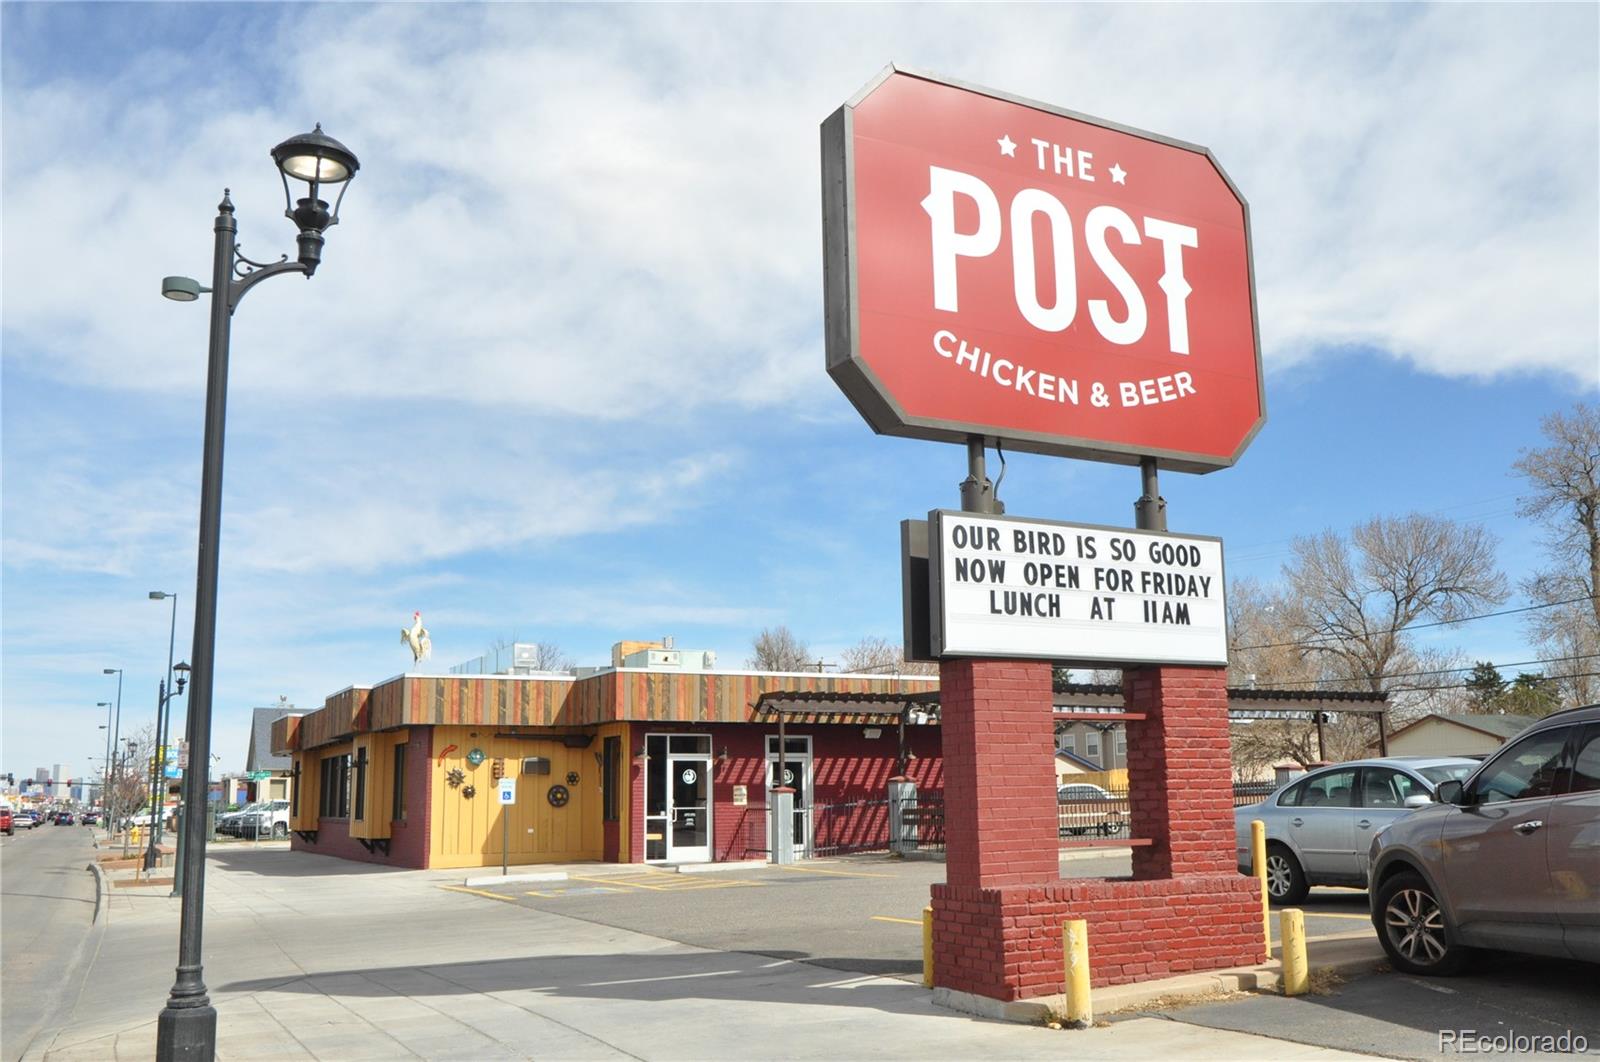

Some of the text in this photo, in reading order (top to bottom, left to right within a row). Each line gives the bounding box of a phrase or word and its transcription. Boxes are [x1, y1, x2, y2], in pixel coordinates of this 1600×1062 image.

[1031, 138, 1095, 182] THE
[920, 165, 1198, 355] POST
[933, 329, 1197, 408] CHICKEN & BEER
[952, 524, 1201, 568] OUR BIRD IS SO GOOD
[955, 557, 1211, 598] NOW OPEN FOR FRIDAY
[990, 590, 1061, 618] LUNCH
[1090, 597, 1115, 620] AT
